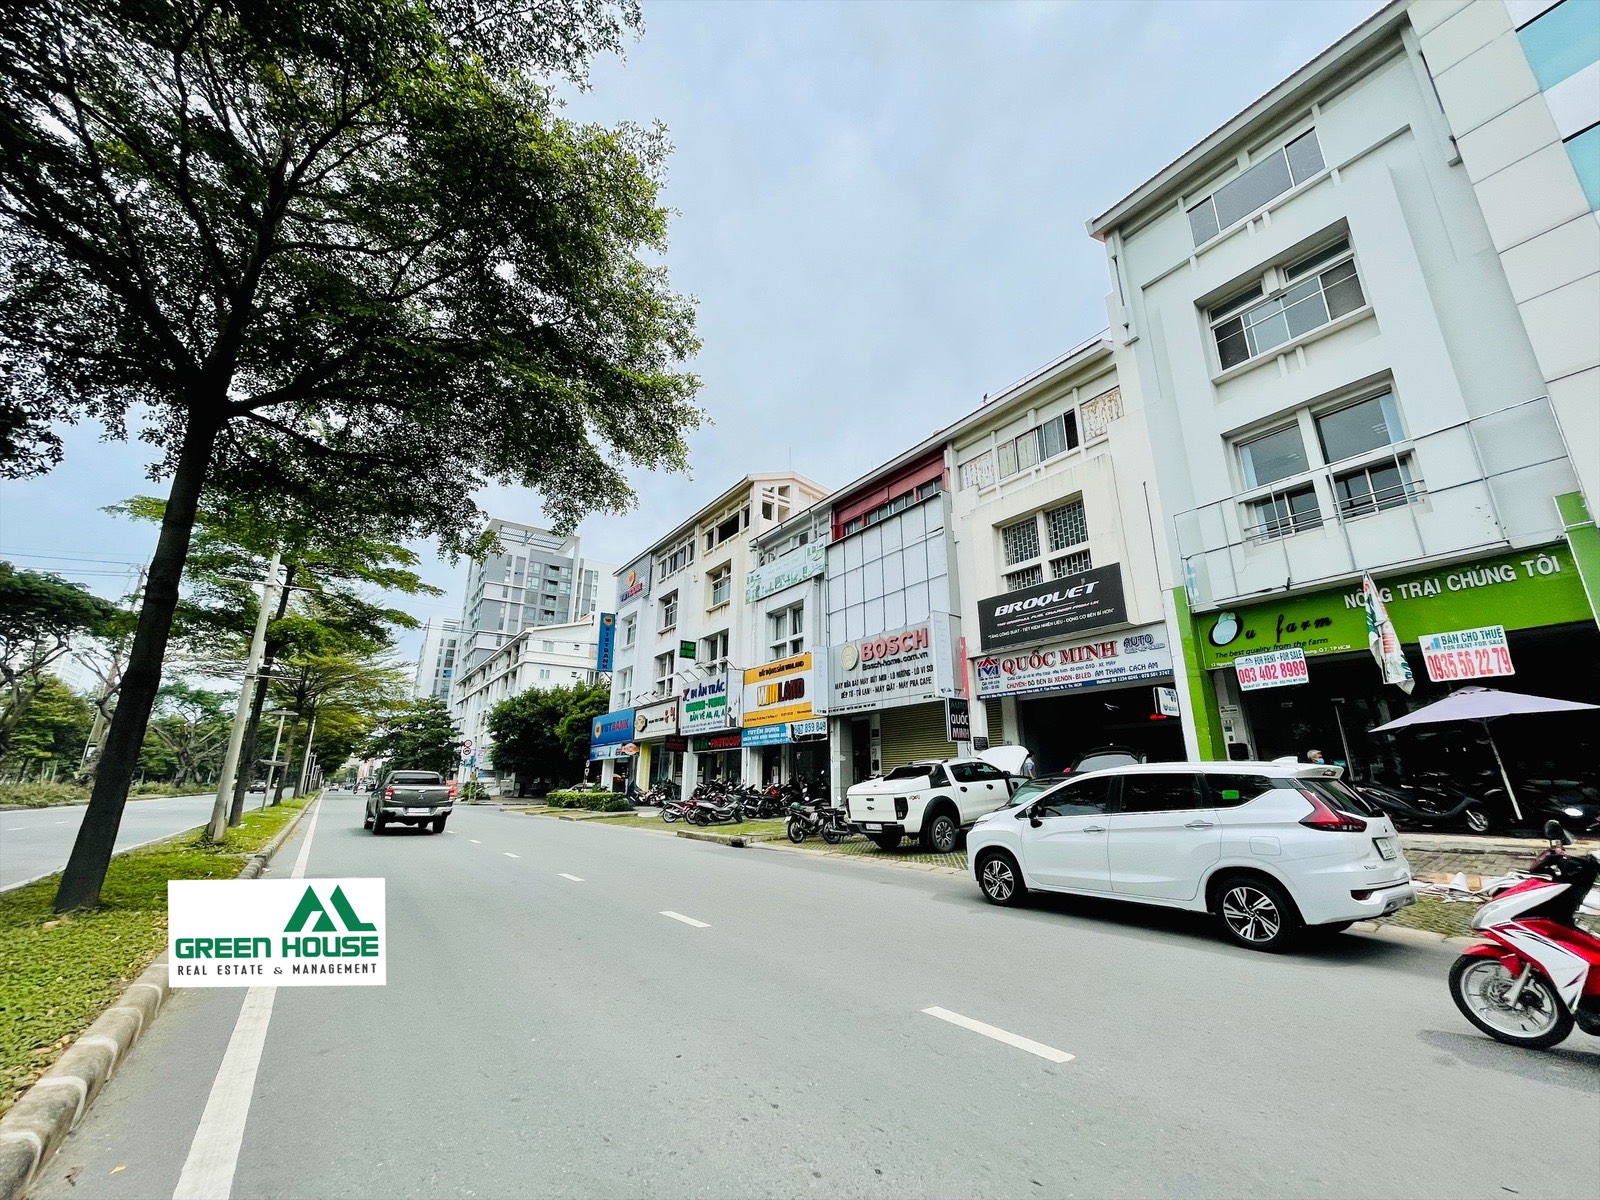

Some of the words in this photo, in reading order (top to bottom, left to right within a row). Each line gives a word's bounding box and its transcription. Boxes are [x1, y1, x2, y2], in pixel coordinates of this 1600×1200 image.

[1344, 584, 1393, 609] NÔG
[1397, 578, 1442, 599] TRẠI
[1446, 564, 1517, 592] CHÚNG
[1521, 553, 1561, 577] TÔI
[994, 581, 1099, 617] BROQUET
[1276, 614, 1332, 643] farm
[1460, 631, 1479, 642] CHO
[861, 628, 928, 662] BOSCH
[1123, 633, 1154, 648] AUTO
[1246, 645, 1271, 655] quality
[1273, 642, 1292, 652] from
[1293, 640, 1307, 648] the
[1308, 637, 1328, 646] farm
[1059, 641, 1118, 664] MINH
[1264, 655, 1276, 664] RENT
[1280, 652, 1290, 661] FOR
[1290, 649, 1303, 660] SALE
[1427, 651, 1458, 681] 0935
[1457, 650, 1476, 677] 56
[1475, 648, 1494, 675] 22
[1492, 646, 1512, 674] 79
[921, 665, 926, 674] VI
[1238, 667, 1257, 684] 093
[1260, 664, 1279, 681] 402
[1280, 660, 1307, 678] 8989
[757, 678, 805, 706] WINLAND
[951, 711, 969, 725] QUỐC
[952, 727, 970, 738] MINH
